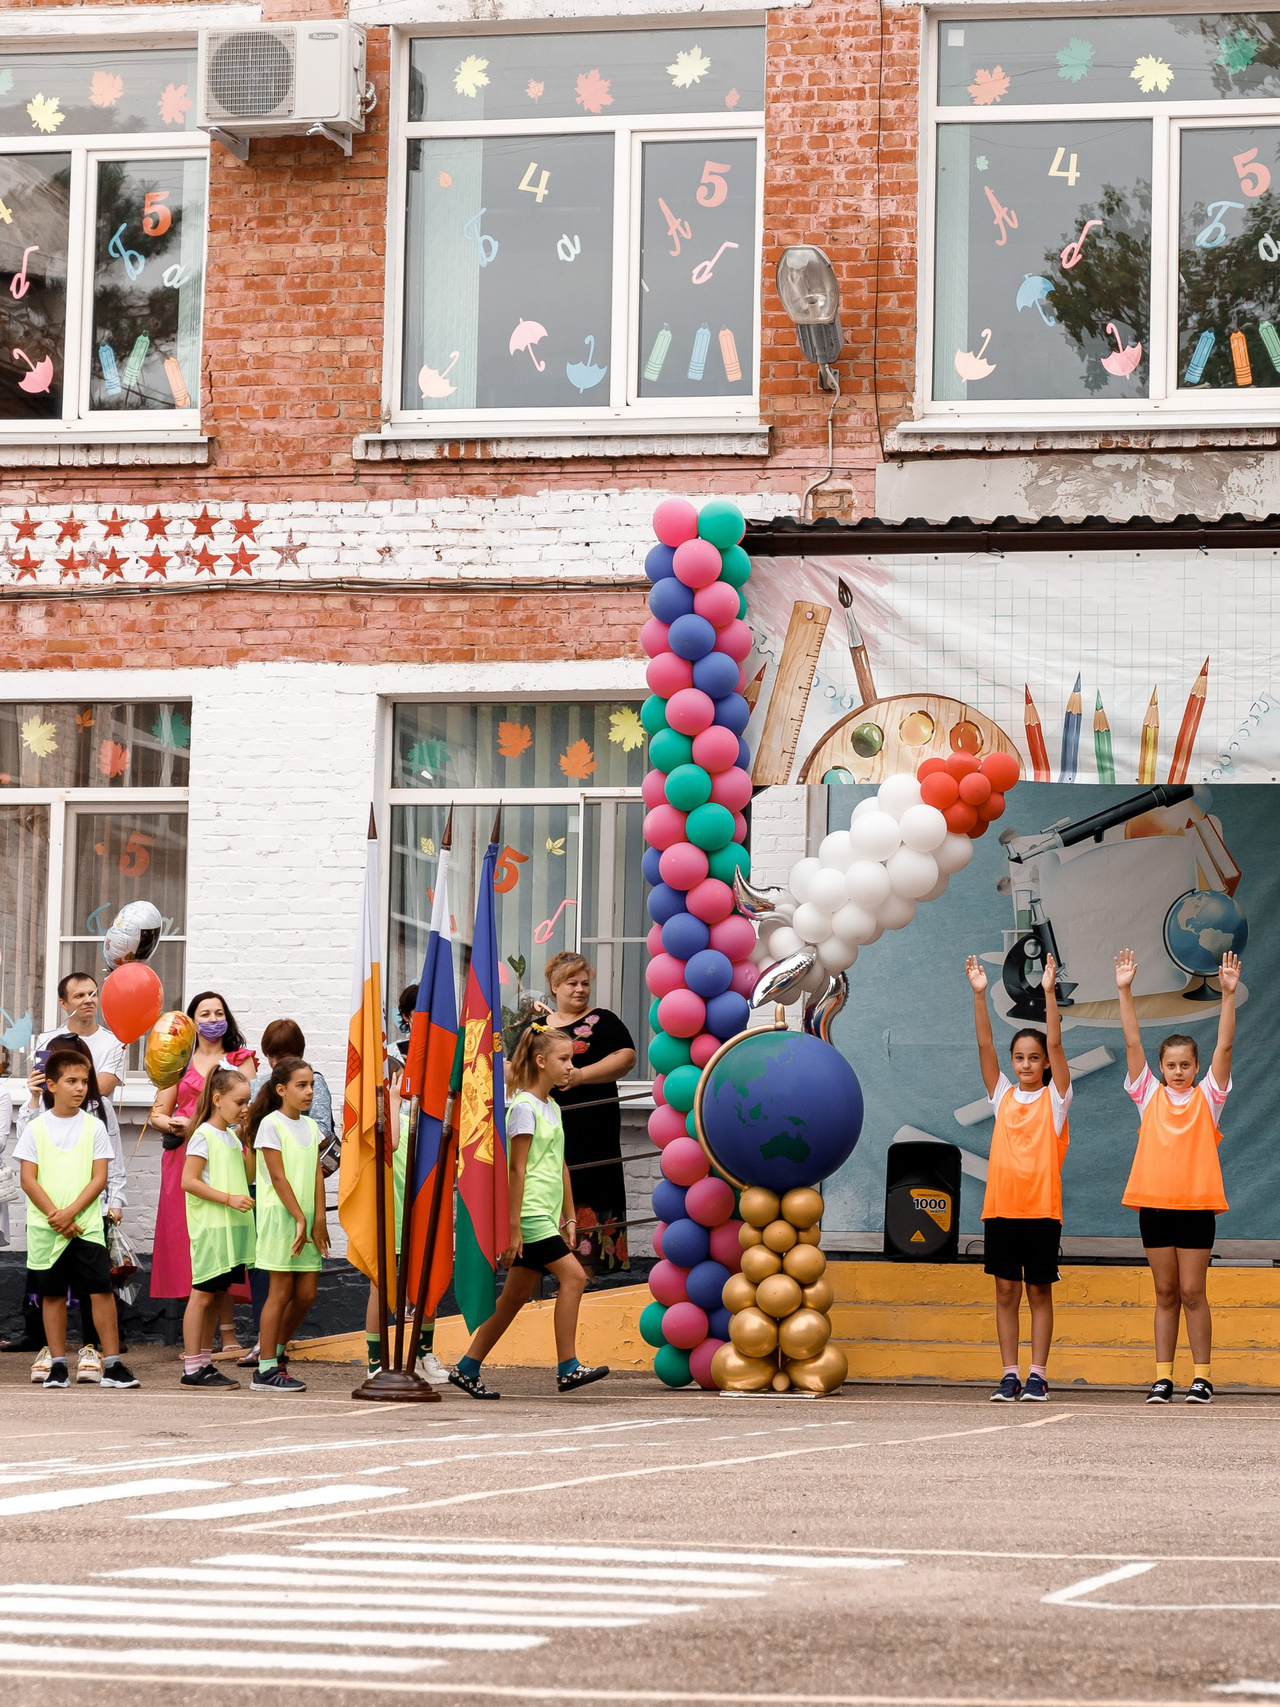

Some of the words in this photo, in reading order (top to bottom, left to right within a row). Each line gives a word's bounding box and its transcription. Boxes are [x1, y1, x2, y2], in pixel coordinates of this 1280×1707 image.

[517, 161, 551, 203] 4
[696, 160, 732, 207] 5
[1048, 146, 1081, 186] 4
[1232, 147, 1271, 197] 5
[142, 190, 172, 237] 5
[119, 830, 156, 878] 5
[493, 844, 530, 893] 5
[913, 1198, 947, 1209] 1000
